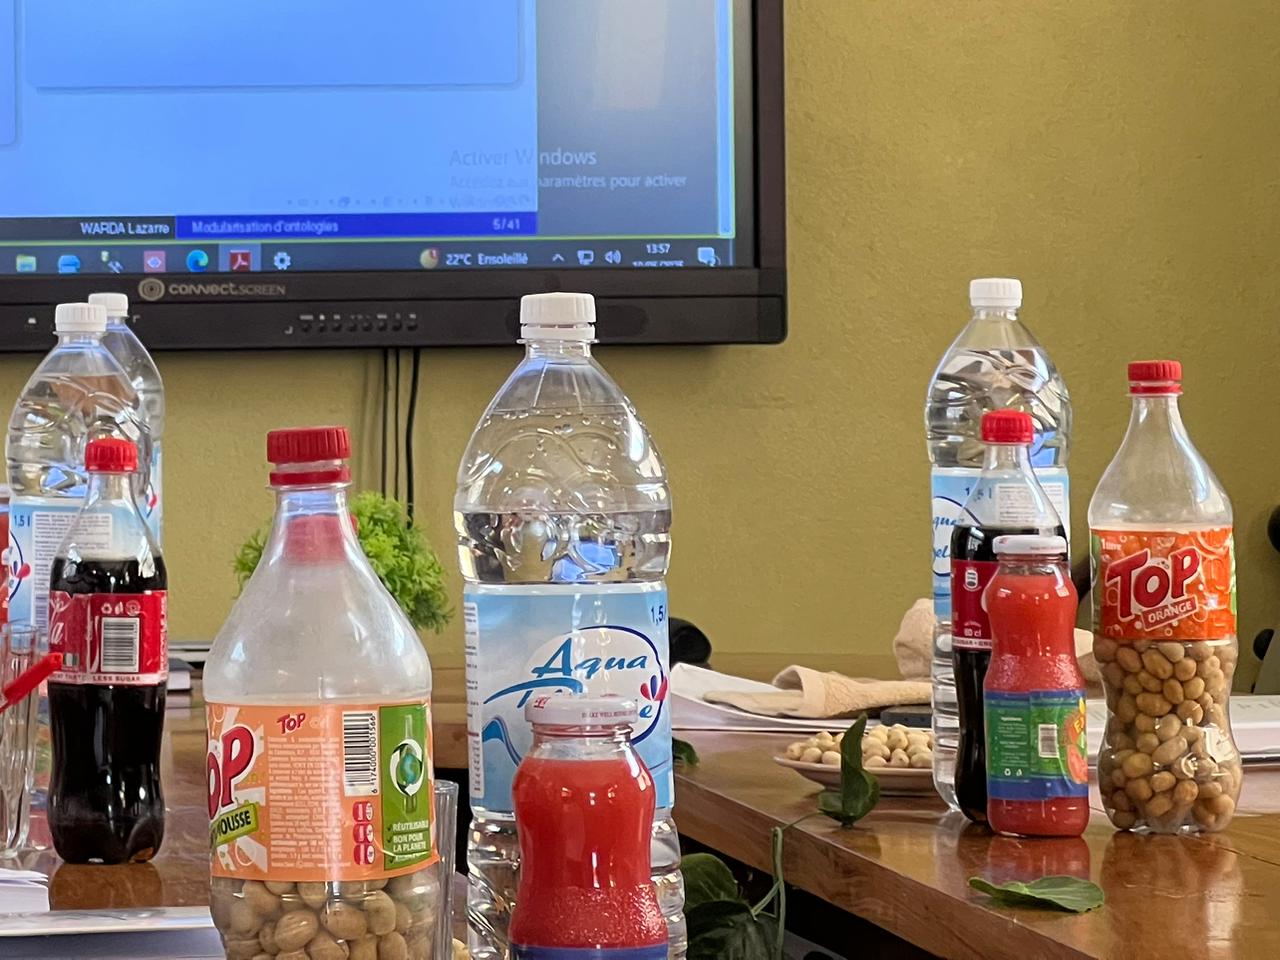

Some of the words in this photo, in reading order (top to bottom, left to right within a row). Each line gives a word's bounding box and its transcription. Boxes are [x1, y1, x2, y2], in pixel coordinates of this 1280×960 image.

[515, 148, 597, 166] Wndows
[611, 177, 641, 190] pour
[645, 175, 688, 187] activer
[80, 222, 124, 235] WARDA
[128, 222, 170, 234] Lazarre
[192, 221, 272, 233] Modularisation
[273, 220, 338, 235] d'ontologies
[446, 253, 472, 265] 22°C
[478, 252, 529, 265] Ensoleillé
[1148, 600, 1193, 623] ORANGE
